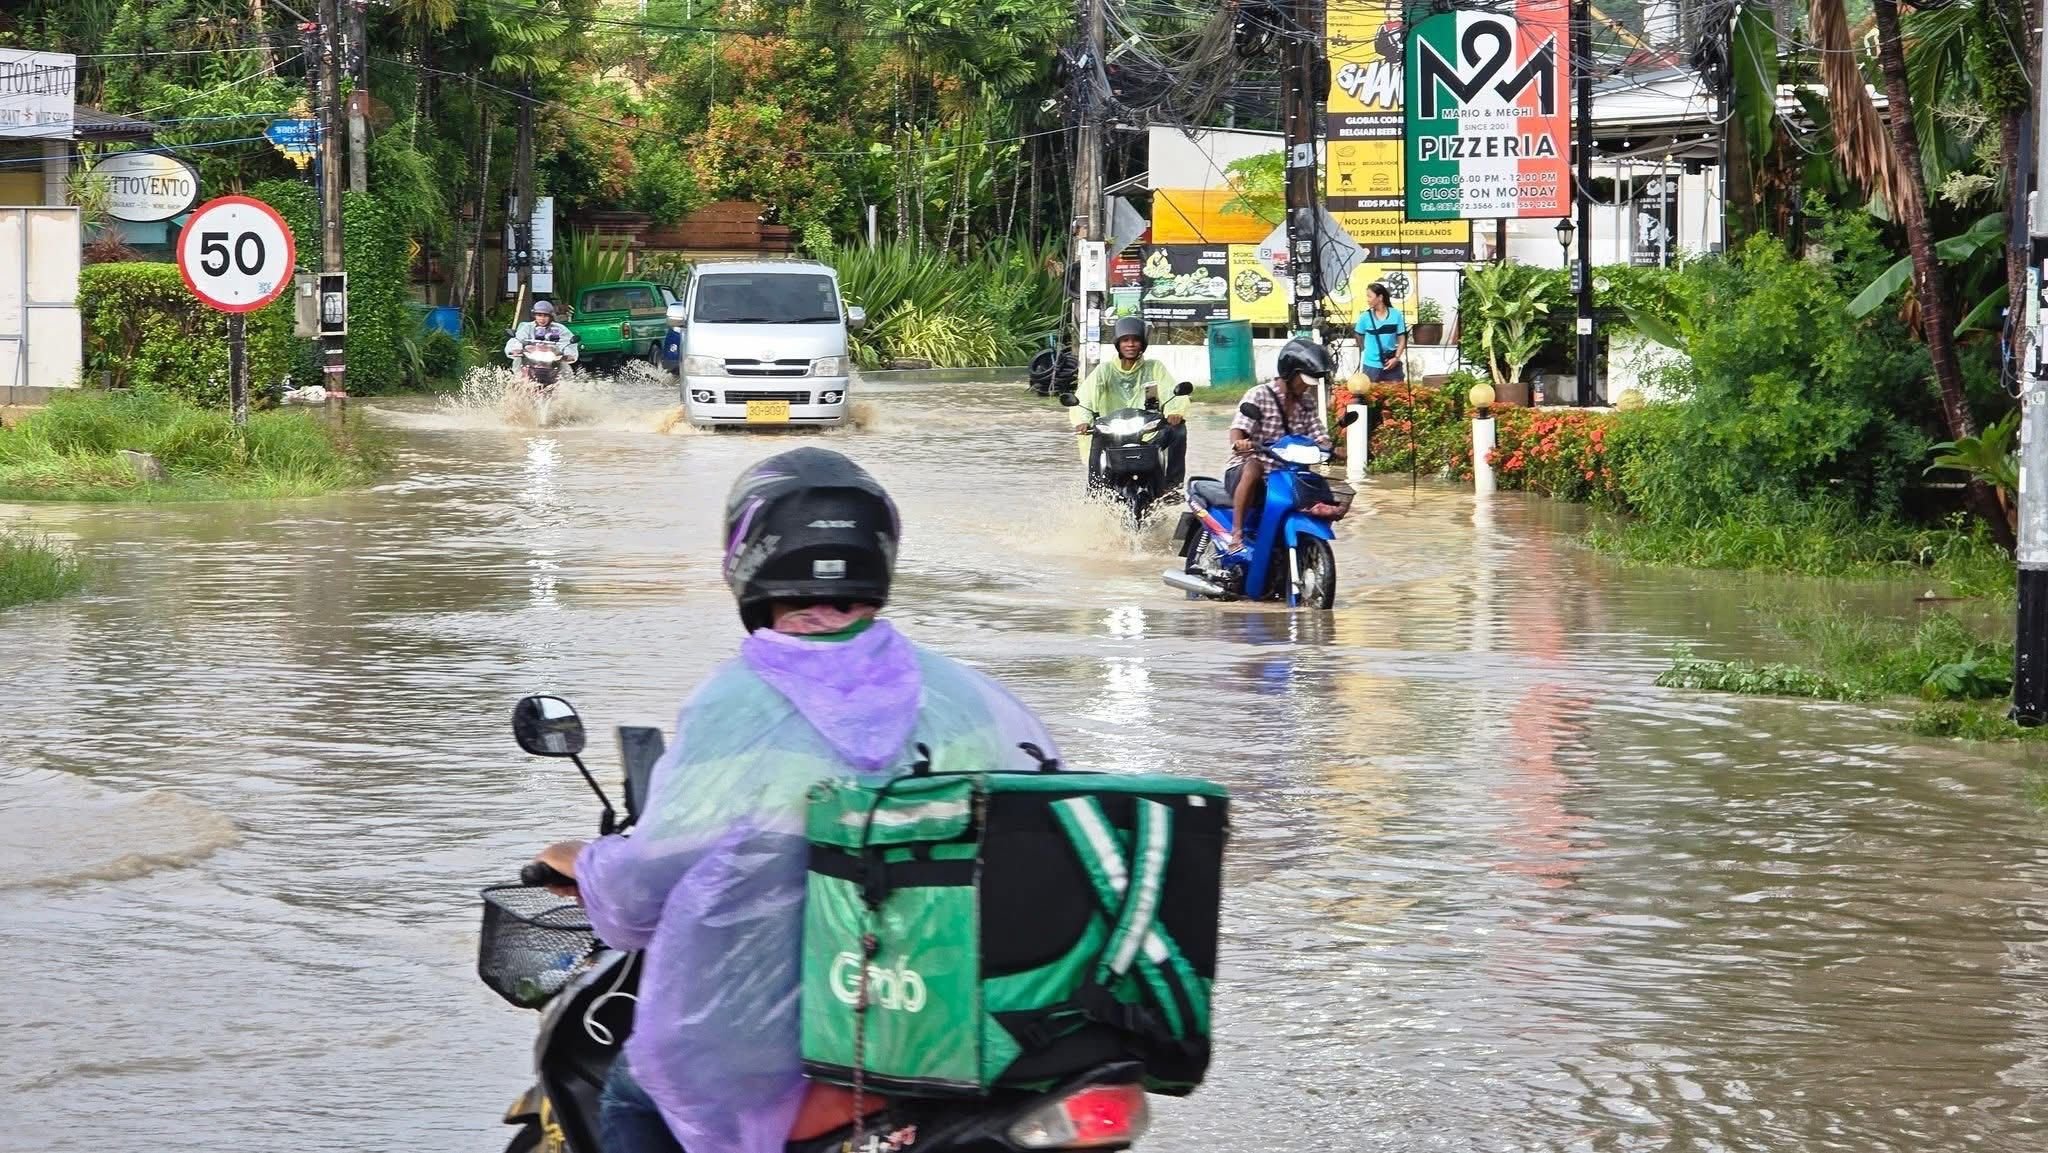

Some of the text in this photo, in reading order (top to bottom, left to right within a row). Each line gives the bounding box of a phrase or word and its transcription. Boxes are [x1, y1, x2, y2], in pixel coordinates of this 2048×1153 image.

[1345, 116, 1379, 124] GLOBAL
[1442, 108, 1532, 119] MARIO & MEGHI
[1340, 128, 1375, 136] BELGIAN
[1420, 135, 1556, 159] PIZZERIA
[104, 175, 190, 197] TTOVENTO
[1421, 175, 1450, 186] Open
[1484, 174, 1500, 183] PM
[1541, 173, 1556, 182] PM
[1421, 186, 1556, 200] CLOSE ON MONDAY
[1344, 218, 1368, 226] NOUS
[1371, 217, 1404, 226] PARLON
[1360, 229, 1396, 237] SPREKEN
[1399, 228, 1452, 237] NEDERLANDS
[201, 231, 265, 277] 50
[830, 951, 927, 1013] Grab
